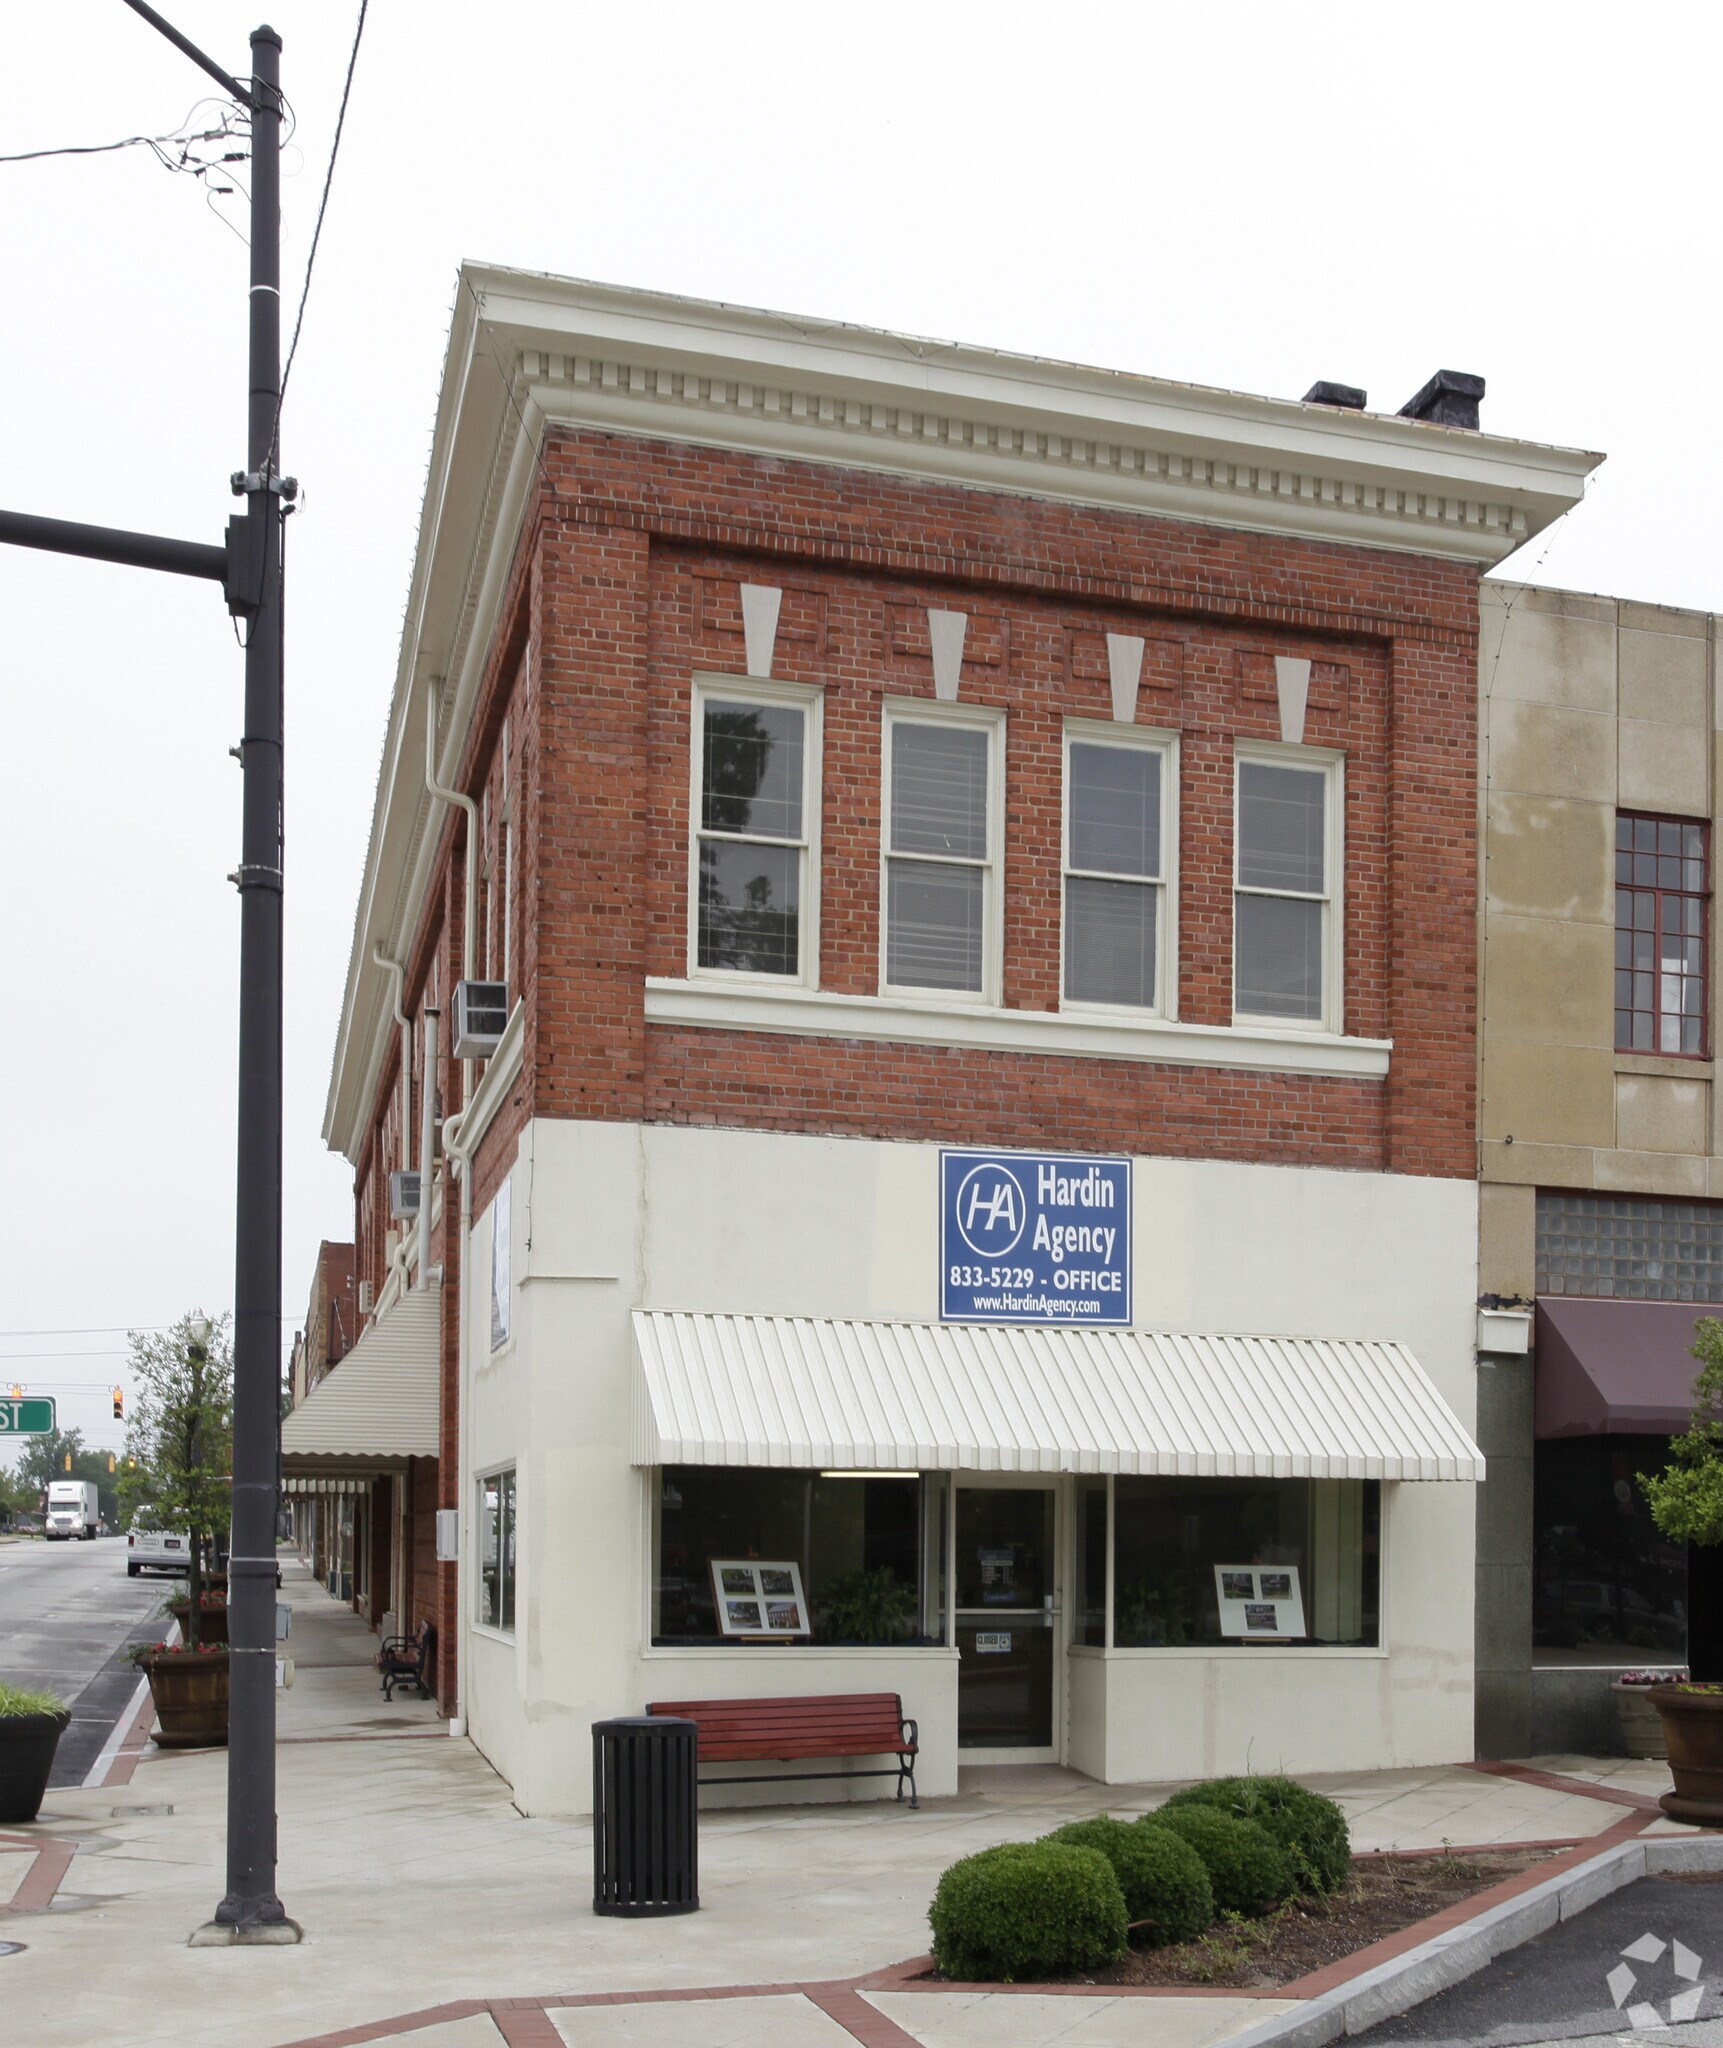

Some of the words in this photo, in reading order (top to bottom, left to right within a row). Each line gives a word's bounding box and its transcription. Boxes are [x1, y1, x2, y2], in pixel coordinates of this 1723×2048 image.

[1038, 1164, 1114, 1208] Hardin
[966, 1183, 1016, 1231] HA
[1032, 1213, 1116, 1265] Agency
[950, 1266, 1034, 1288] 833-5229
[1053, 1269, 1122, 1292] OFFICE
[973, 1293, 1100, 1318] www.HardinAgency.com
[977, 1634, 998, 1644] CLOSED
